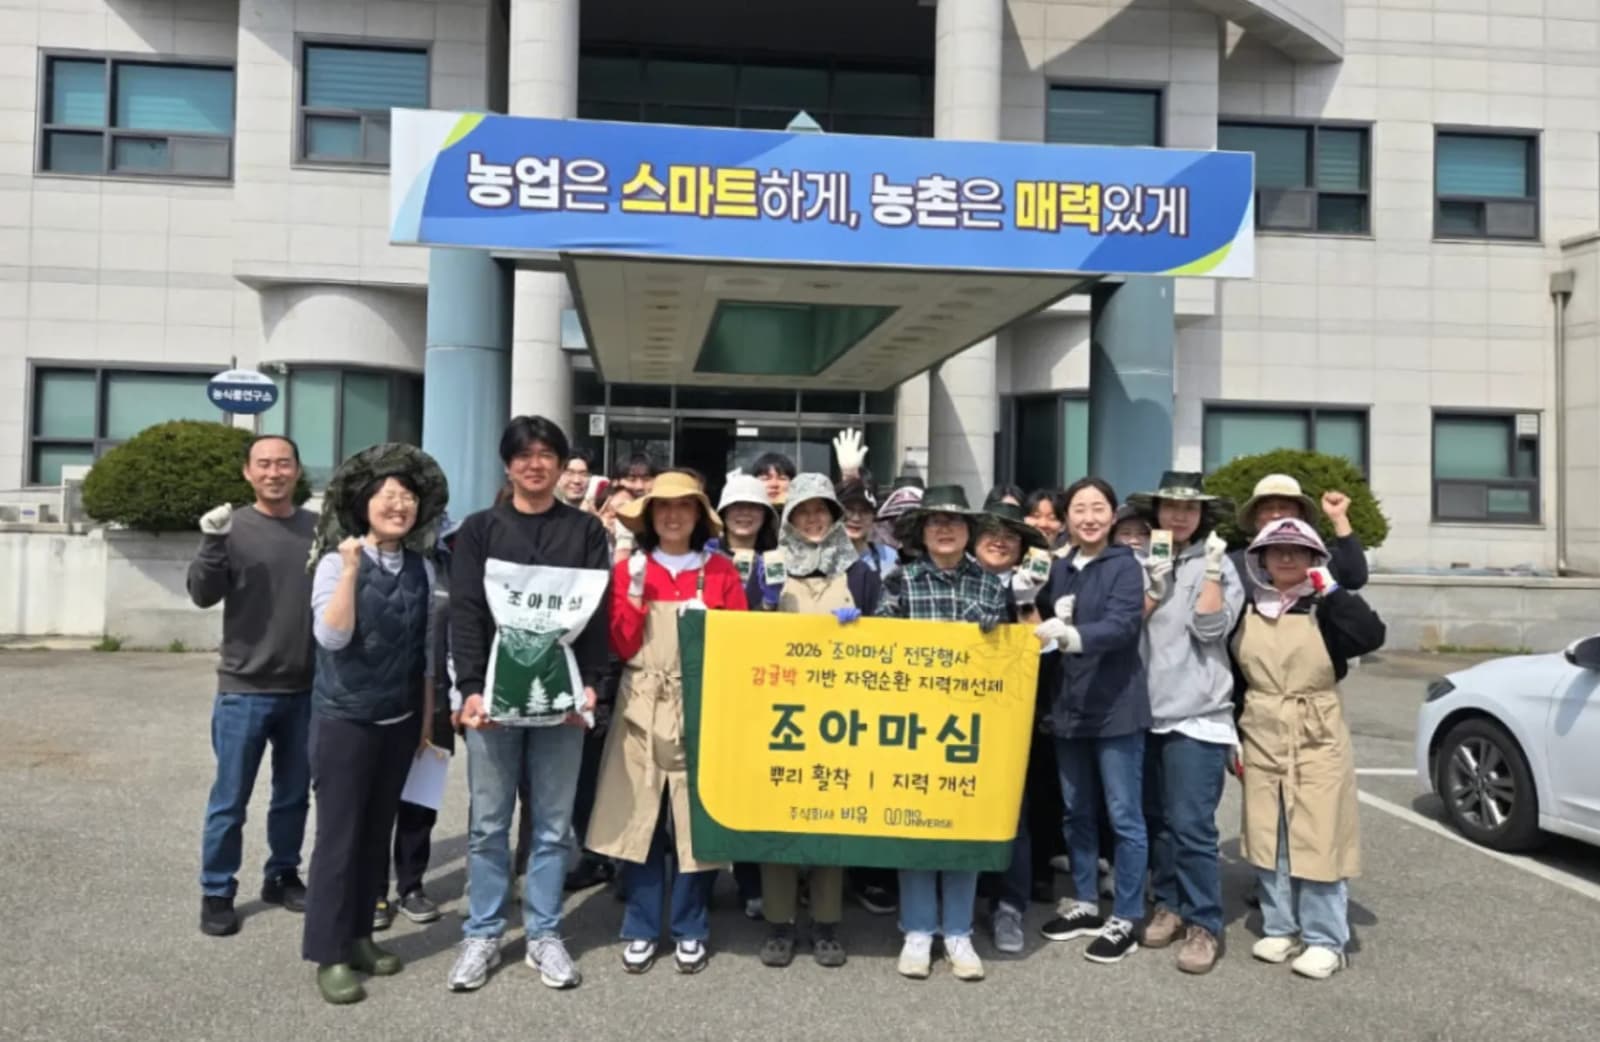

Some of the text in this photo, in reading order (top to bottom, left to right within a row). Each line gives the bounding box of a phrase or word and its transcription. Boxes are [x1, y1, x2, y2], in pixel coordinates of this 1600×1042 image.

[466, 152, 1189, 236] 농업은 스마트하게, 농촌은 매력있게
[507, 589, 583, 612] 조아마심
[785, 642, 822, 658] 2026
[903, 646, 971, 668] 전달행사
[806, 669, 837, 689] 기반
[844, 670, 911, 692] 자원순환
[918, 676, 1004, 697] 지력개선제
[768, 703, 981, 764] 조아마심
[770, 765, 803, 787] 뿌리
[812, 763, 851, 791] 활착
[893, 773, 929, 795] 지력
[938, 775, 976, 797] 개선
[789, 805, 868, 824] 주식회사 비유
